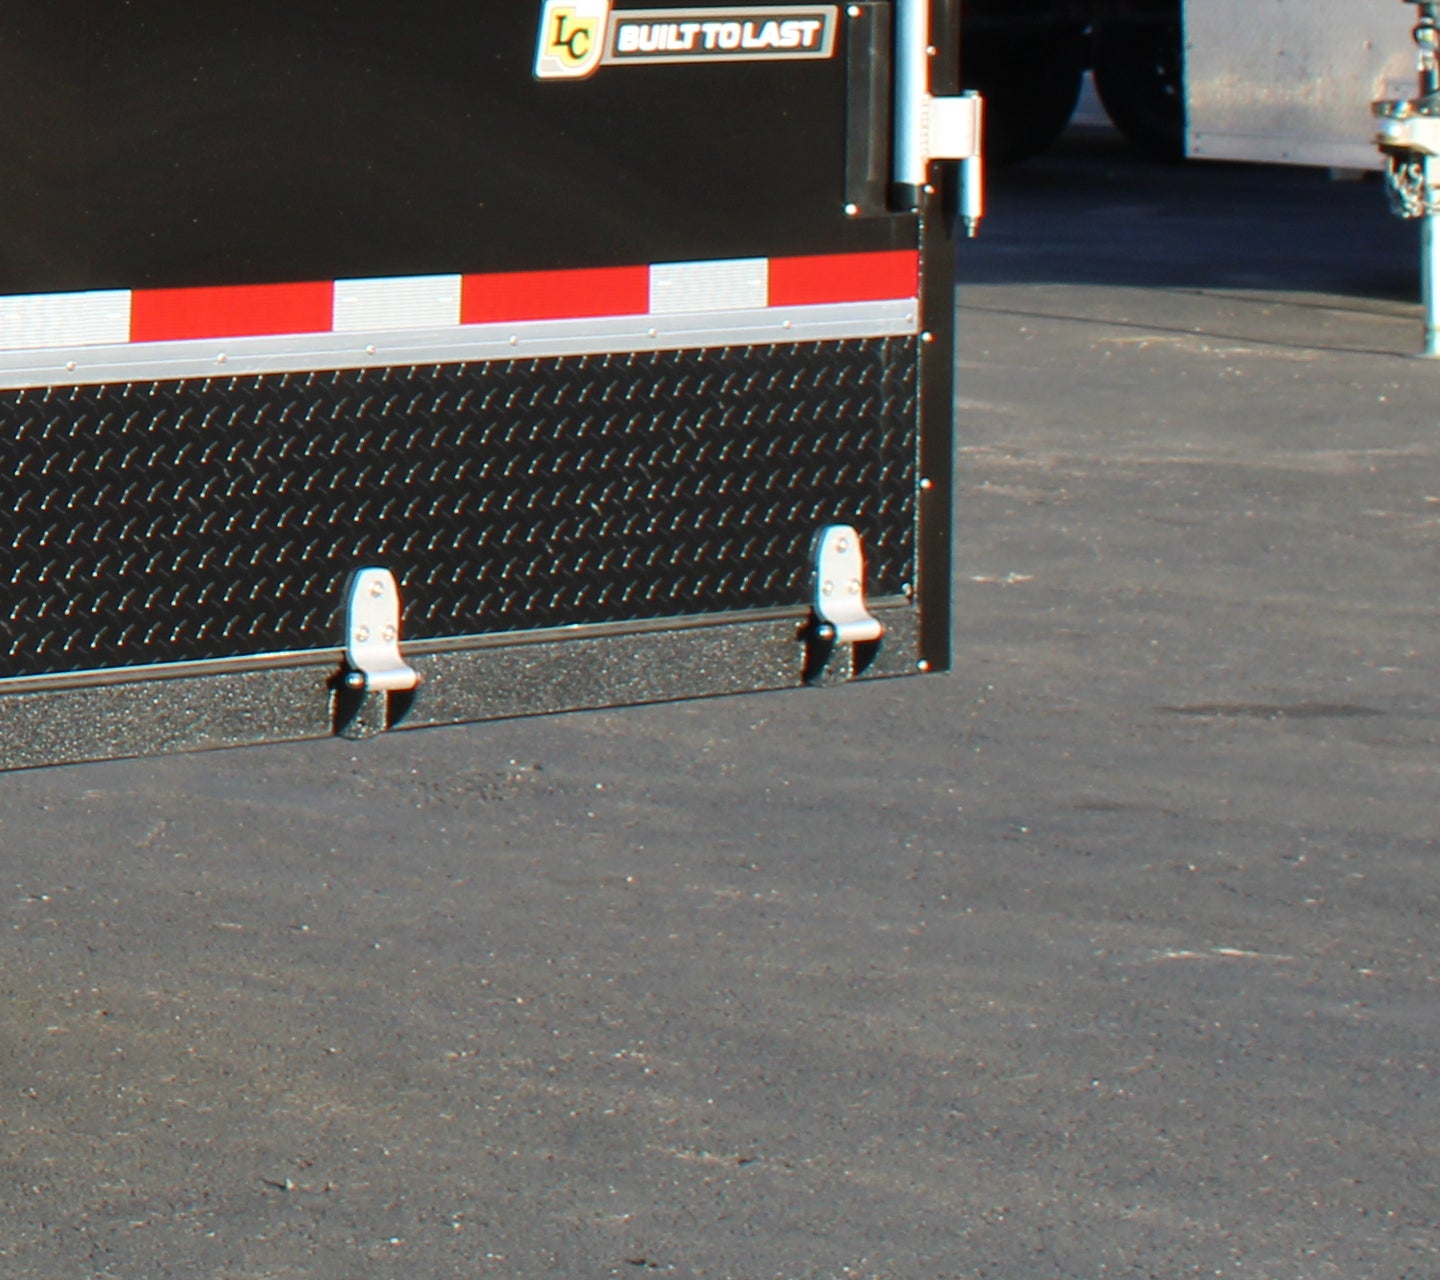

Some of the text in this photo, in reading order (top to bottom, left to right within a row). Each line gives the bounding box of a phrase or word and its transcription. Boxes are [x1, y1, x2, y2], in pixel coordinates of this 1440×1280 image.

[617, 23, 702, 52] BUILT
[701, 22, 741, 49] TO
[741, 20, 822, 48] LAST
